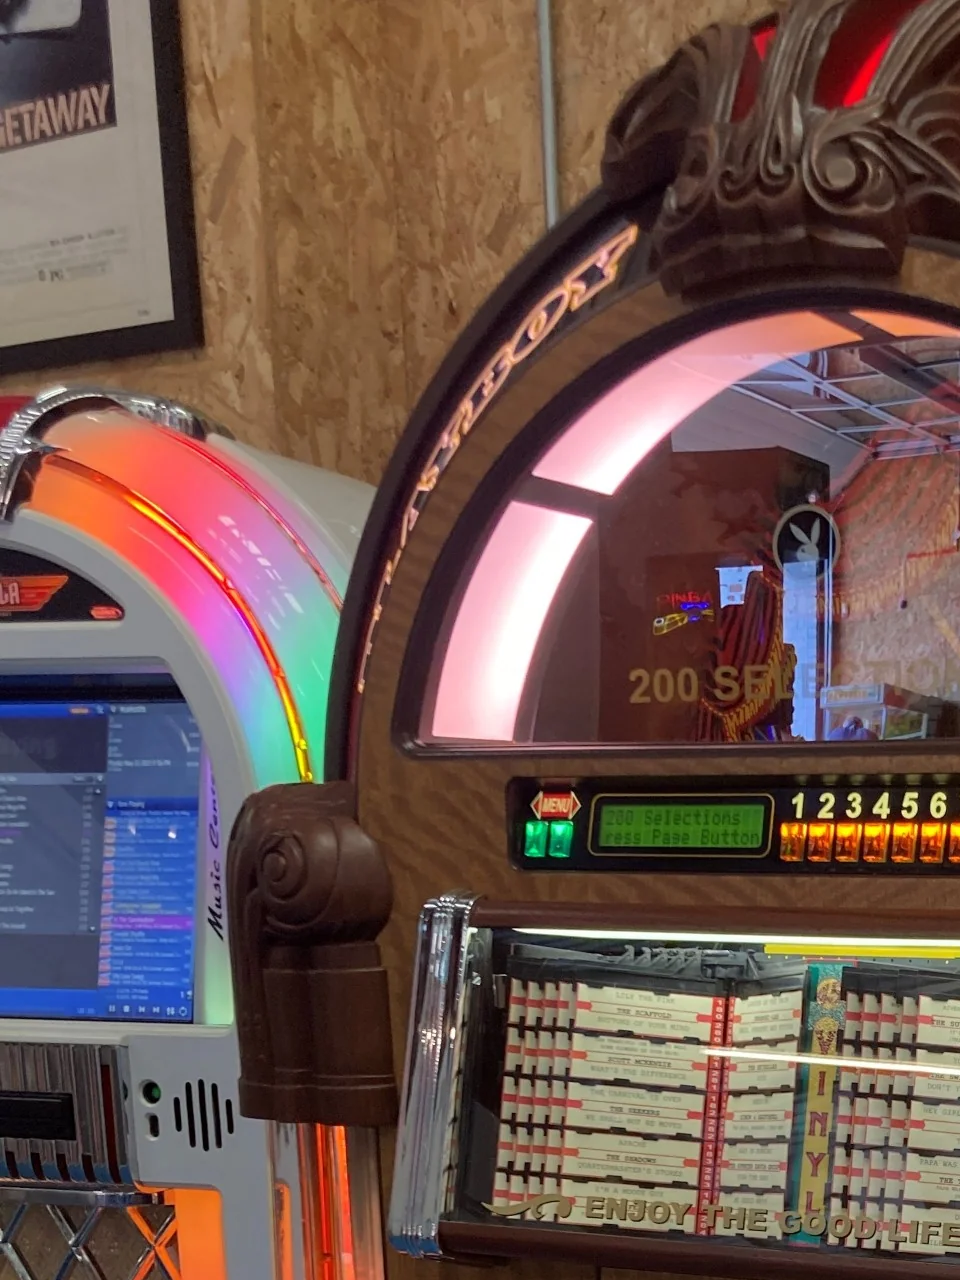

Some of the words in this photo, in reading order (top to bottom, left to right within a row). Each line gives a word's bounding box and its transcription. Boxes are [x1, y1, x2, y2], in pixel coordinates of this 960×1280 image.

[0, 84, 110, 150] ETAWAY
[628, 667, 698, 703] 200
[541, 798, 571, 813] MENU
[791, 791, 804, 819] 1
[817, 791, 835, 819] 2
[845, 791, 862, 819] 3
[872, 791, 890, 819] 4
[900, 791, 919, 819] 5
[929, 791, 947, 819] 6
[606, 810, 634, 826] 200
[644, 809, 741, 826] Selections
[652, 831, 690, 846] Page
[701, 830, 761, 845] Button
[207, 859, 224, 941] Music
[927, 1082, 951, 1091] DON'T
[922, 1106, 938, 1115] HEY
[942, 1108, 960, 1118] GIRL
[919, 1158, 939, 1167] PAPA
[943, 1160, 957, 1168] WAS
[586, 1196, 693, 1225] ENJOY
[702, 1203, 768, 1232] THE
[778, 1210, 877, 1240] GOOD
